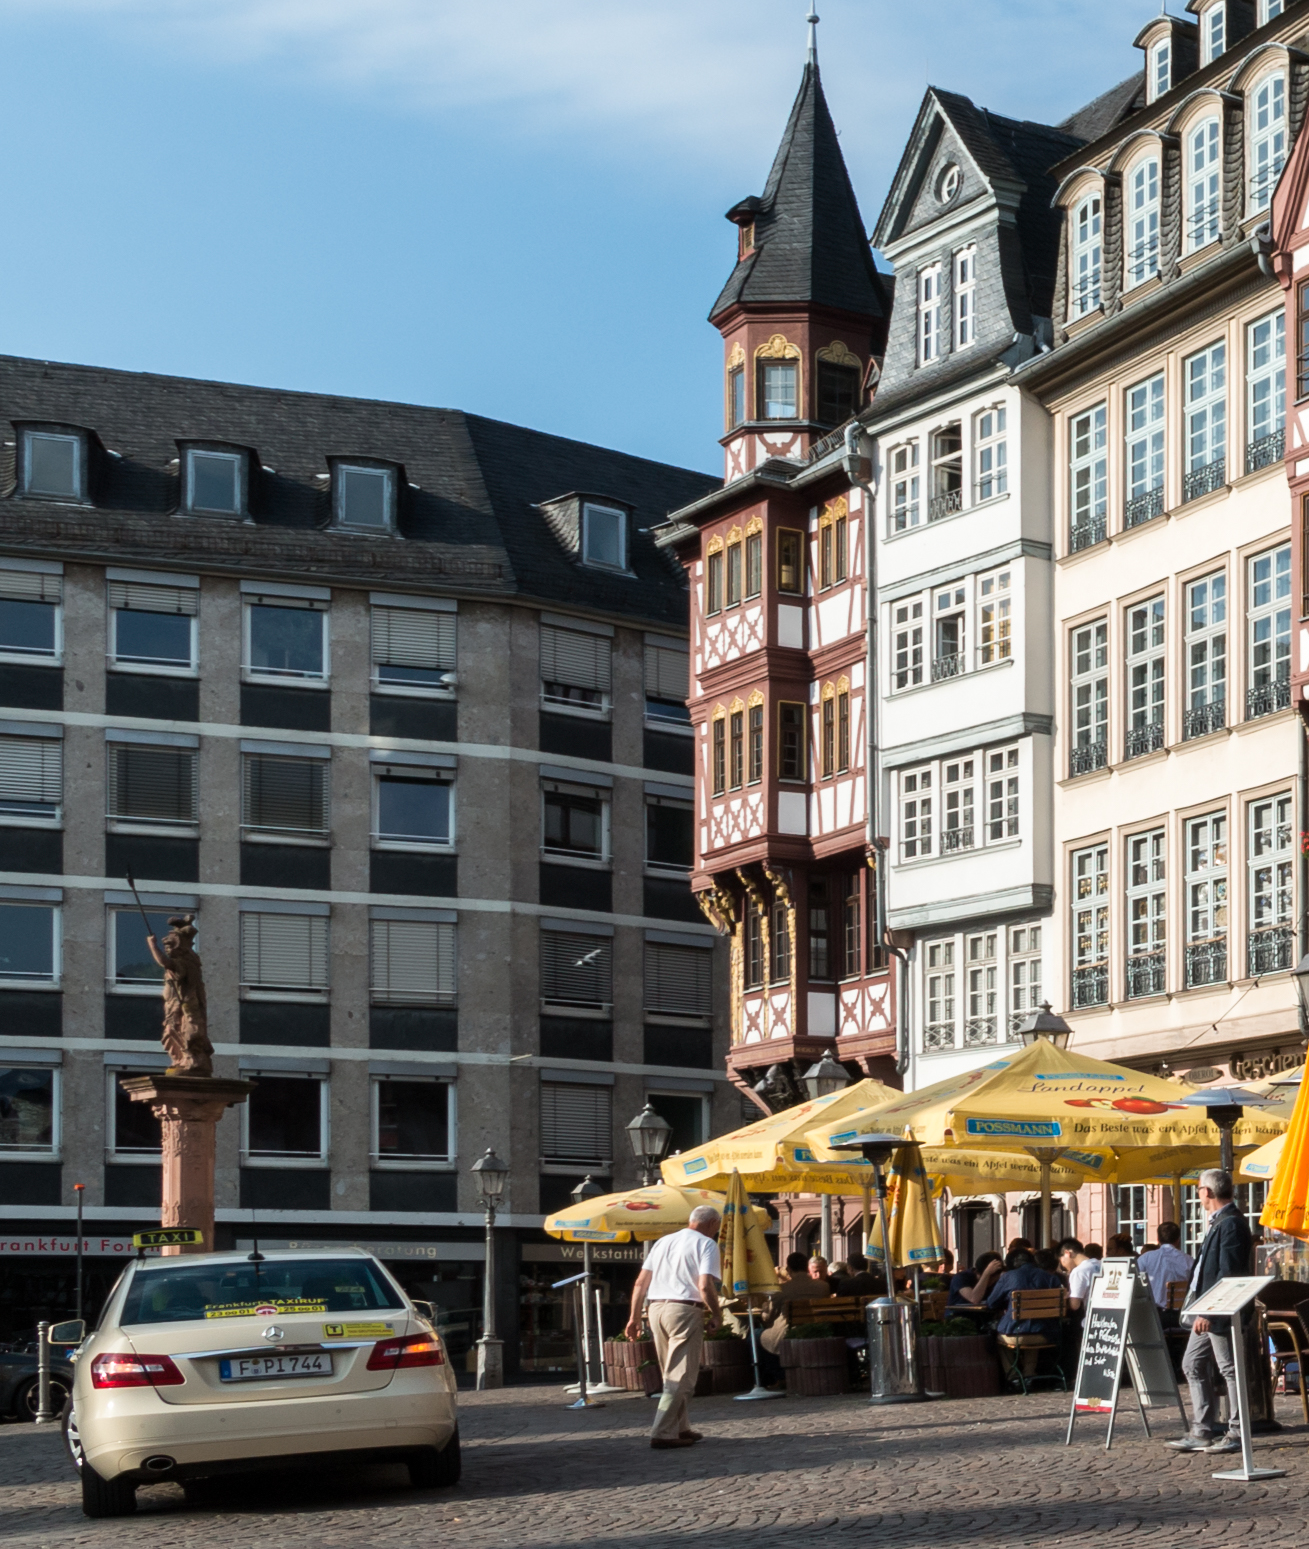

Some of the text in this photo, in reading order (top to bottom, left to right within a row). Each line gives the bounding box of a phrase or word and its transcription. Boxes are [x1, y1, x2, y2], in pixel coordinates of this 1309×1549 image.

[1229, 1051, 1307, 1081] Geschen
[1017, 1082, 1146, 1094] Landappel
[975, 1120, 1053, 1135] POSSMANN
[1074, 1122, 1097, 1133] Das
[1100, 1123, 1129, 1134] Beste
[1132, 1125, 1155, 1134] was
[1158, 1125, 1176, 1134] ein
[1181, 1124, 1207, 1136] Apfel
[983, 1159, 1008, 1170] Apfel
[0, 1237, 90, 1252] rankfurt
[148, 1232, 189, 1243] TAXI
[210, 1309, 223, 1317] 23
[239, 1356, 323, 1375] F PI 744
